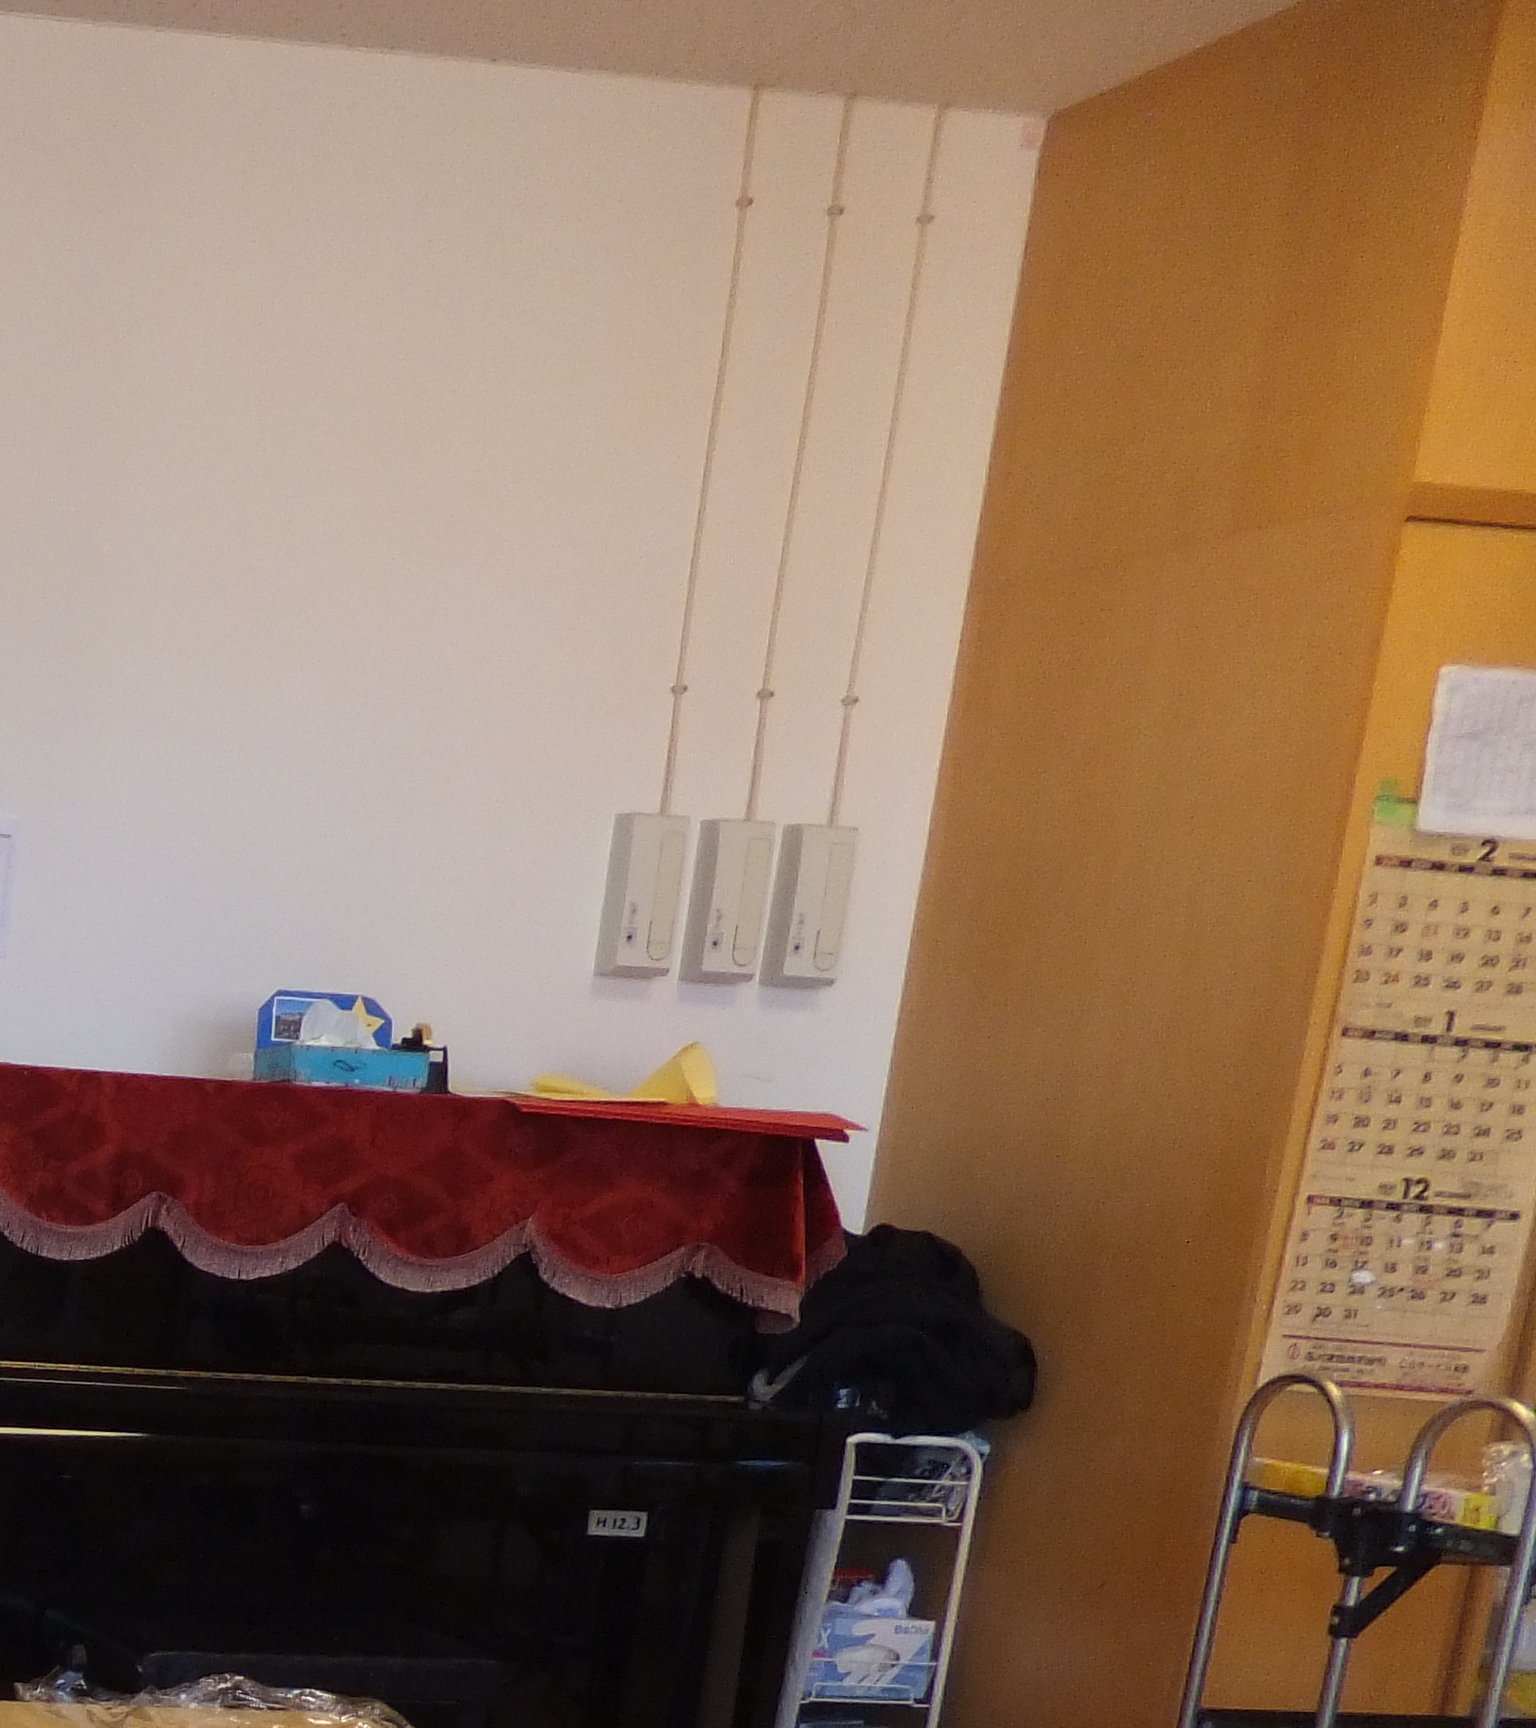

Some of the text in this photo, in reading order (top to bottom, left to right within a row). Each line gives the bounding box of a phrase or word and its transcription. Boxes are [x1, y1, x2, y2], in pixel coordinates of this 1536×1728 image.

[1478, 837, 1499, 863] 2
[1446, 1010, 1457, 1033] 1
[1401, 1176, 1431, 1201] 12
